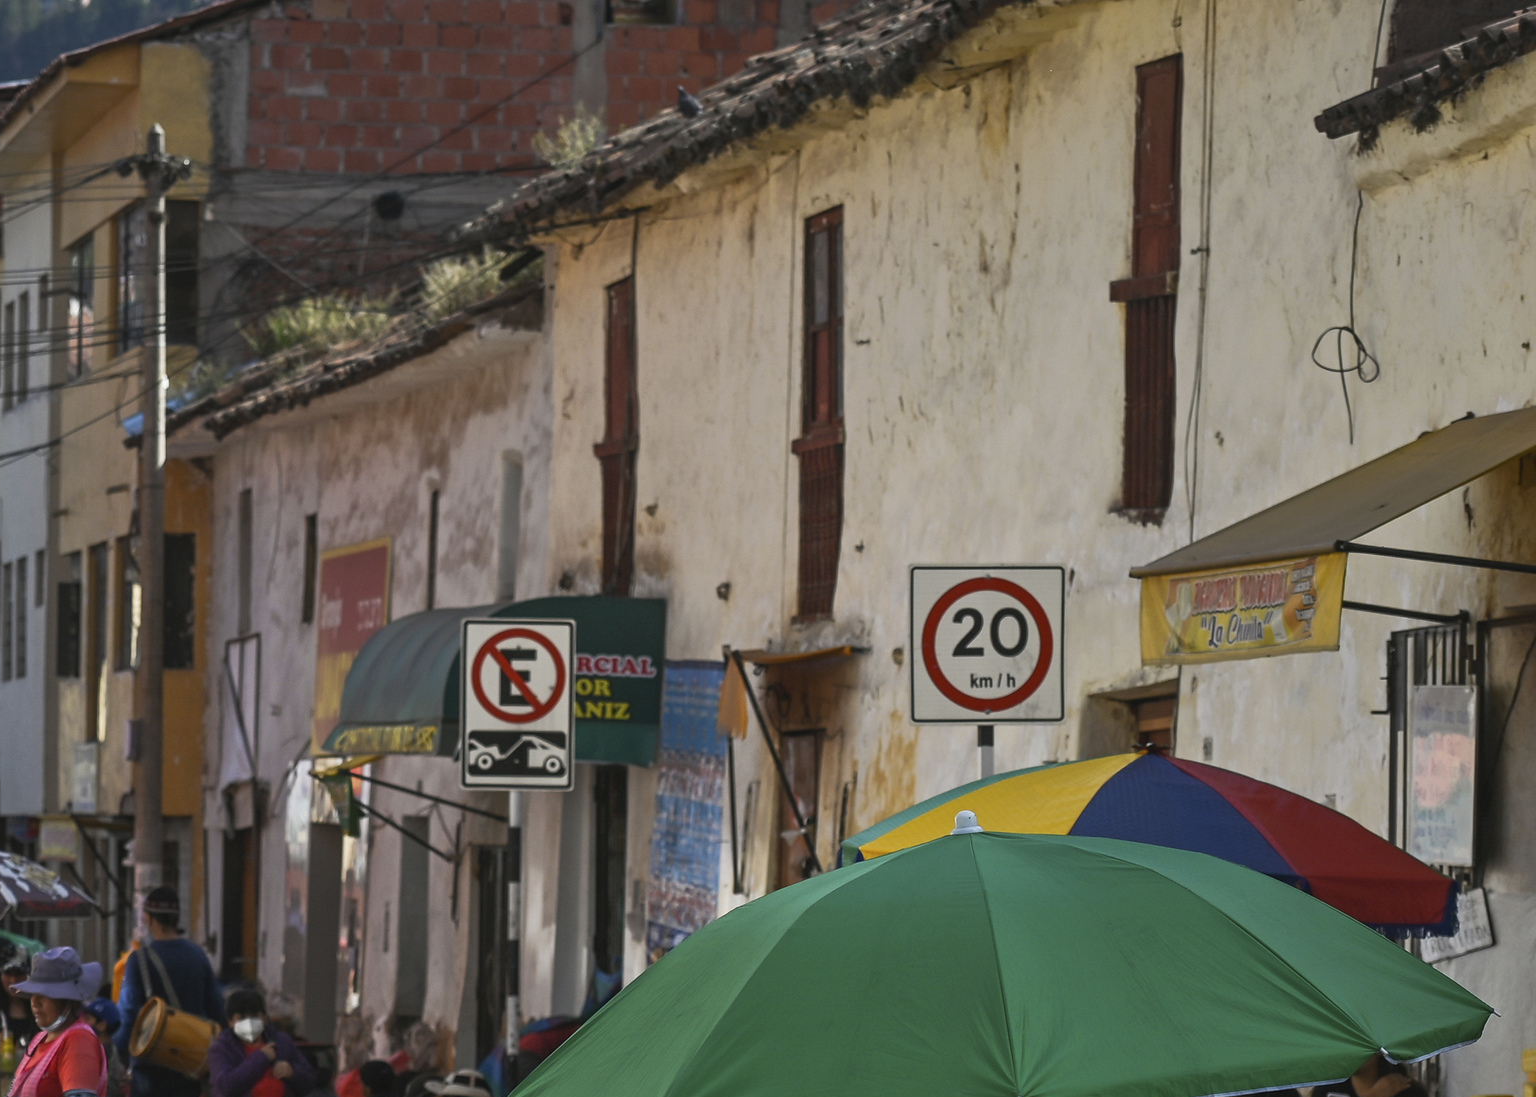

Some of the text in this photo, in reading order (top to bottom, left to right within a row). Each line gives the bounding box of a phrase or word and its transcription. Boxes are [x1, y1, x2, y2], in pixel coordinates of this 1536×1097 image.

[951, 607, 1029, 658] 20
[575, 653, 656, 678] RCIAL
[970, 673, 993, 688] km
[1007, 673, 1016, 688] h
